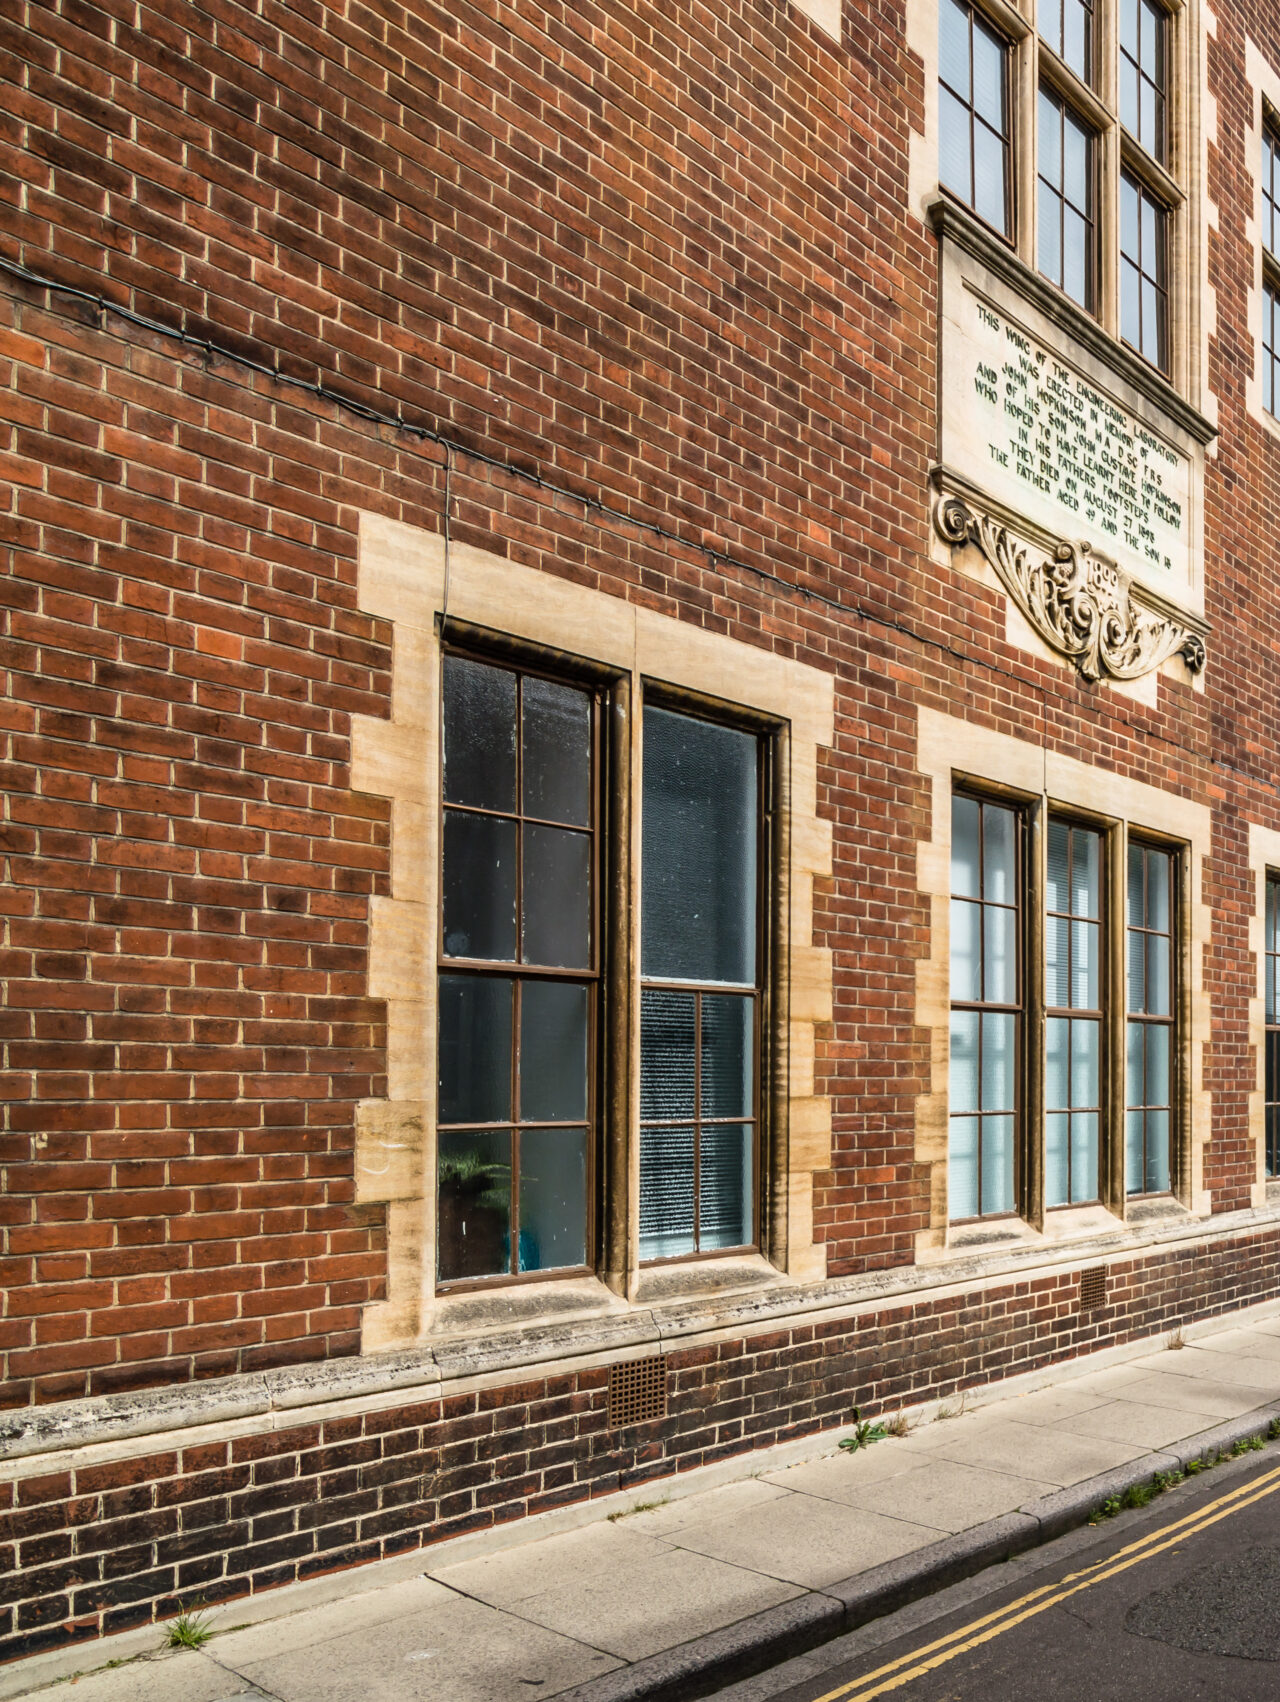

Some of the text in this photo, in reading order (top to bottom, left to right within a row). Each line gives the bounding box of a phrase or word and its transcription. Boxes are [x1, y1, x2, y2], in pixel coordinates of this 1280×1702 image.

[976, 303, 1179, 467] THIS WING OF THE ENGINEERING LABORATORY
[976, 361, 1181, 516] AND OF HIS SON JOHN GUSTAVE HOPKINSON
[1002, 362, 1027, 389] JOHN
[1037, 385, 1086, 432] HOPKINSON
[1019, 354, 1149, 461] WAS ERECTED IN MEMORY OF
[975, 378, 1181, 530] WHO HOPED TO HAVE LEARNT HERE TO FOLLOW
[988, 443, 1009, 468] THE
[1016, 461, 1051, 494] FATHER
[1057, 488, 1079, 512] AGED
[1086, 508, 1096, 521] 49
[1101, 517, 1118, 536] AND
[1123, 530, 1139, 550] THE
[1144, 545, 1160, 564] SON
[1010, 439, 1035, 465] THEY
[1040, 458, 1060, 481] DIED
[1065, 477, 1077, 494] ON
[1084, 489, 1118, 519] AUGUST
[1123, 514, 1133, 529] 27
[1019, 426, 1149, 524] IN HIS FATHERS FOOTSTEPS
